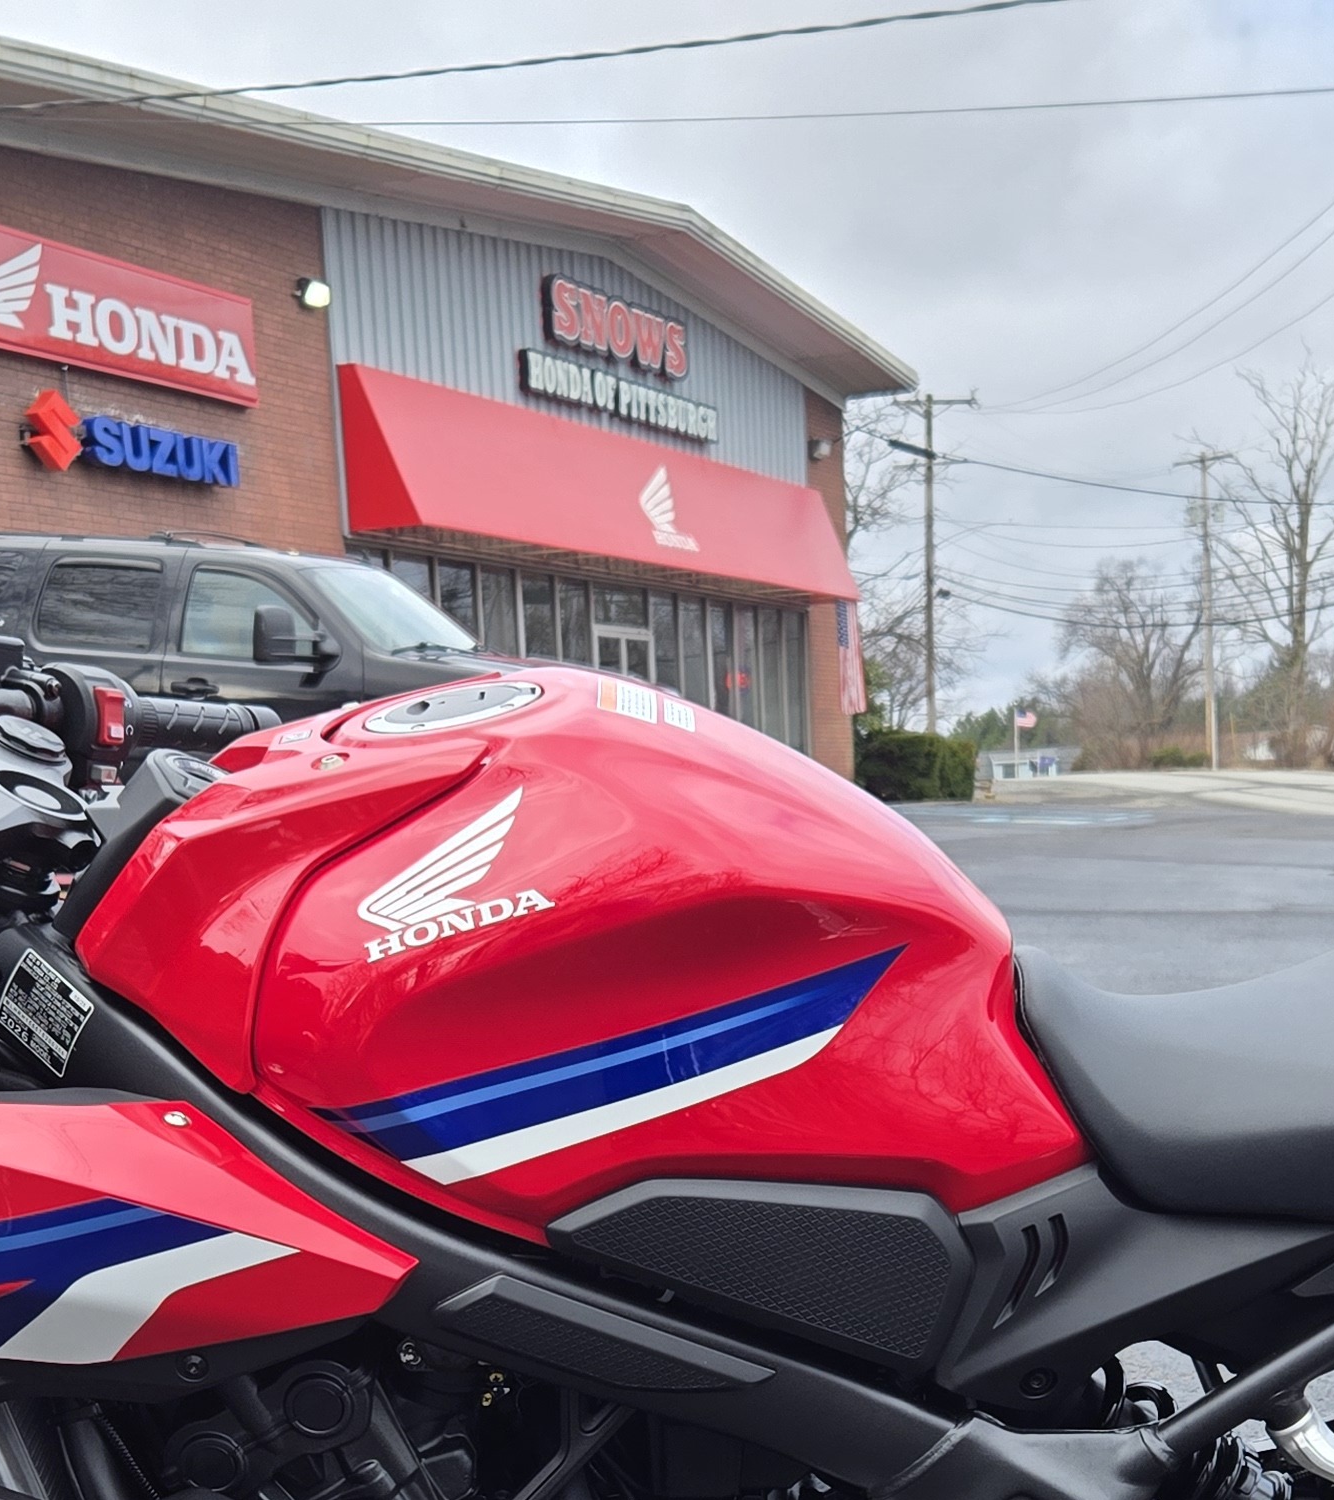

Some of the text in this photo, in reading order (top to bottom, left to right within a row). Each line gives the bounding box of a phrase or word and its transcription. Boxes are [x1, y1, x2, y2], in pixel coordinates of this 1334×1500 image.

[44, 282, 256, 386] HONDA
[552, 278, 687, 378] SNOWS
[527, 350, 717, 441] HONDA OF PITTSBURGH
[83, 414, 240, 488] SUZUKI
[364, 888, 556, 963] HONDA
[0, 1011, 29, 1042] 2026
[30, 1041, 52, 1064] MODEL
